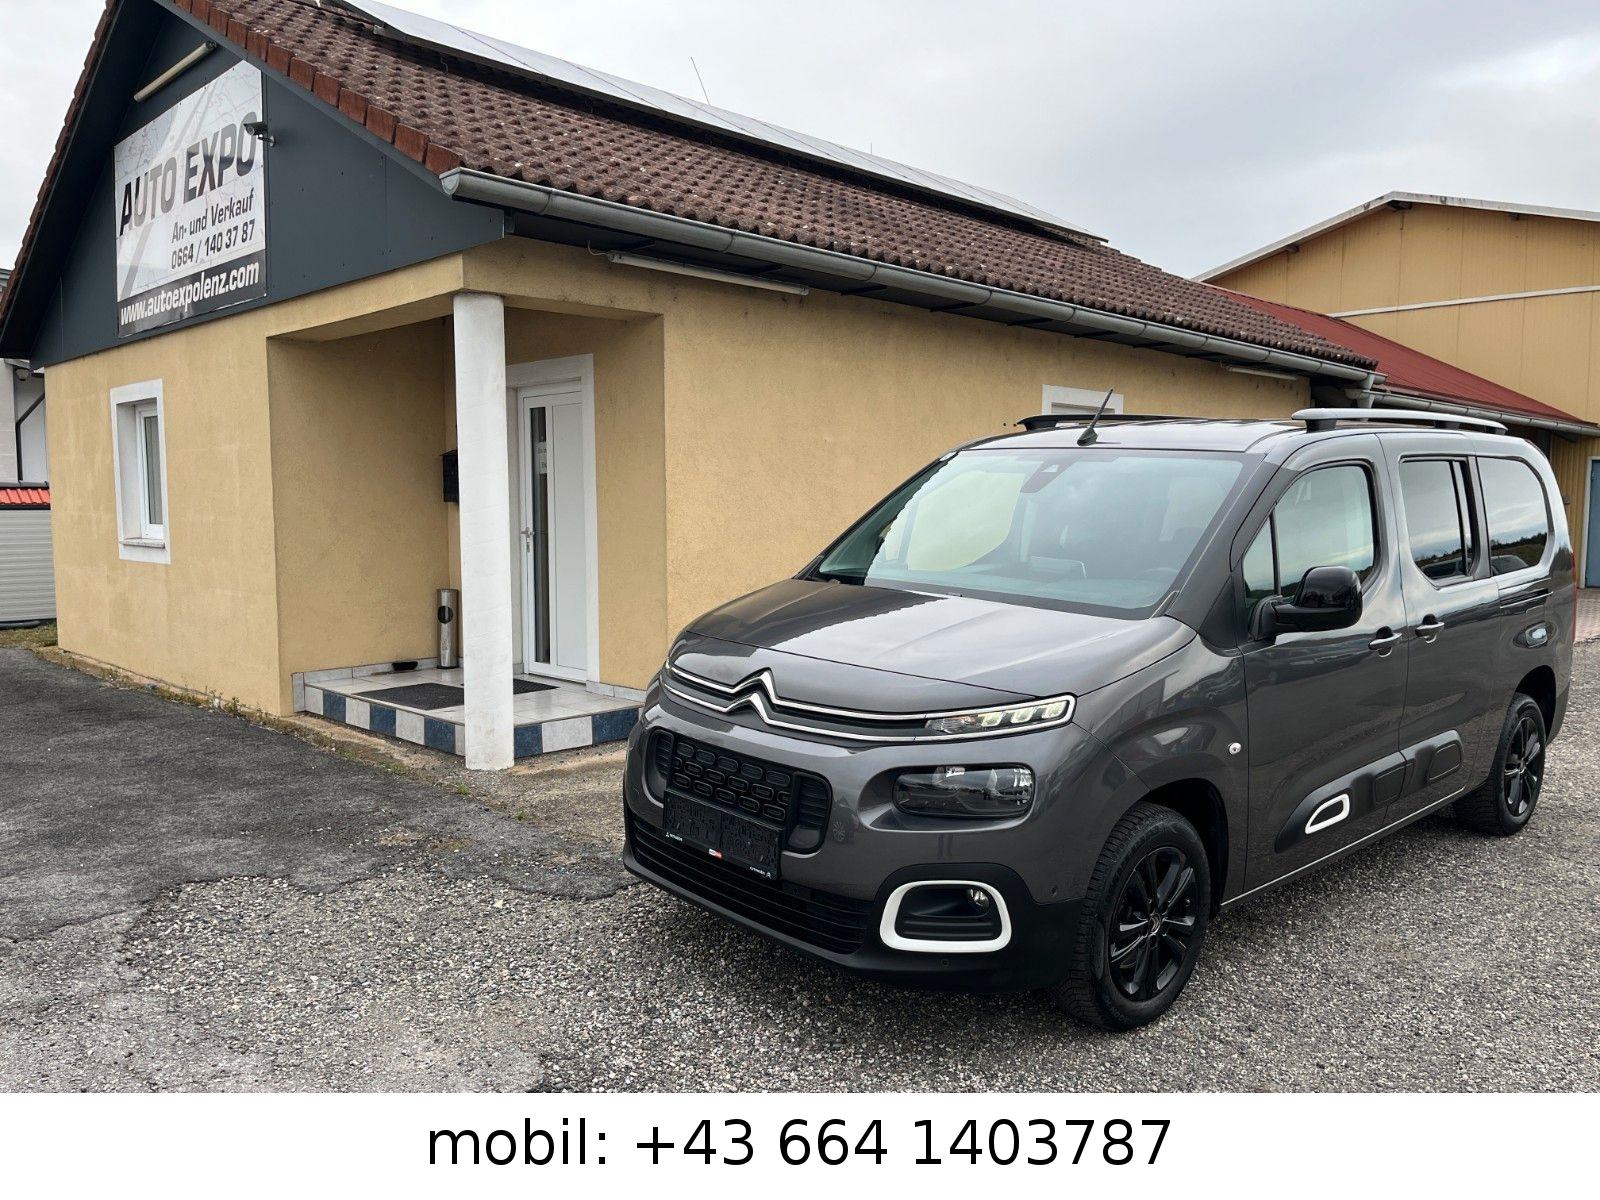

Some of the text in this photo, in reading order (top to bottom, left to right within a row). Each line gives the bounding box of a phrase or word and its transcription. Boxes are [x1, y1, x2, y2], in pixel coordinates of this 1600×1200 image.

[120, 111, 257, 236] AUTO EXPO
[171, 219, 255, 269] 0664 / 140 37 87
[172, 187, 254, 243] An- und Verkauf
[121, 261, 260, 325] www.autoexpolenz.com
